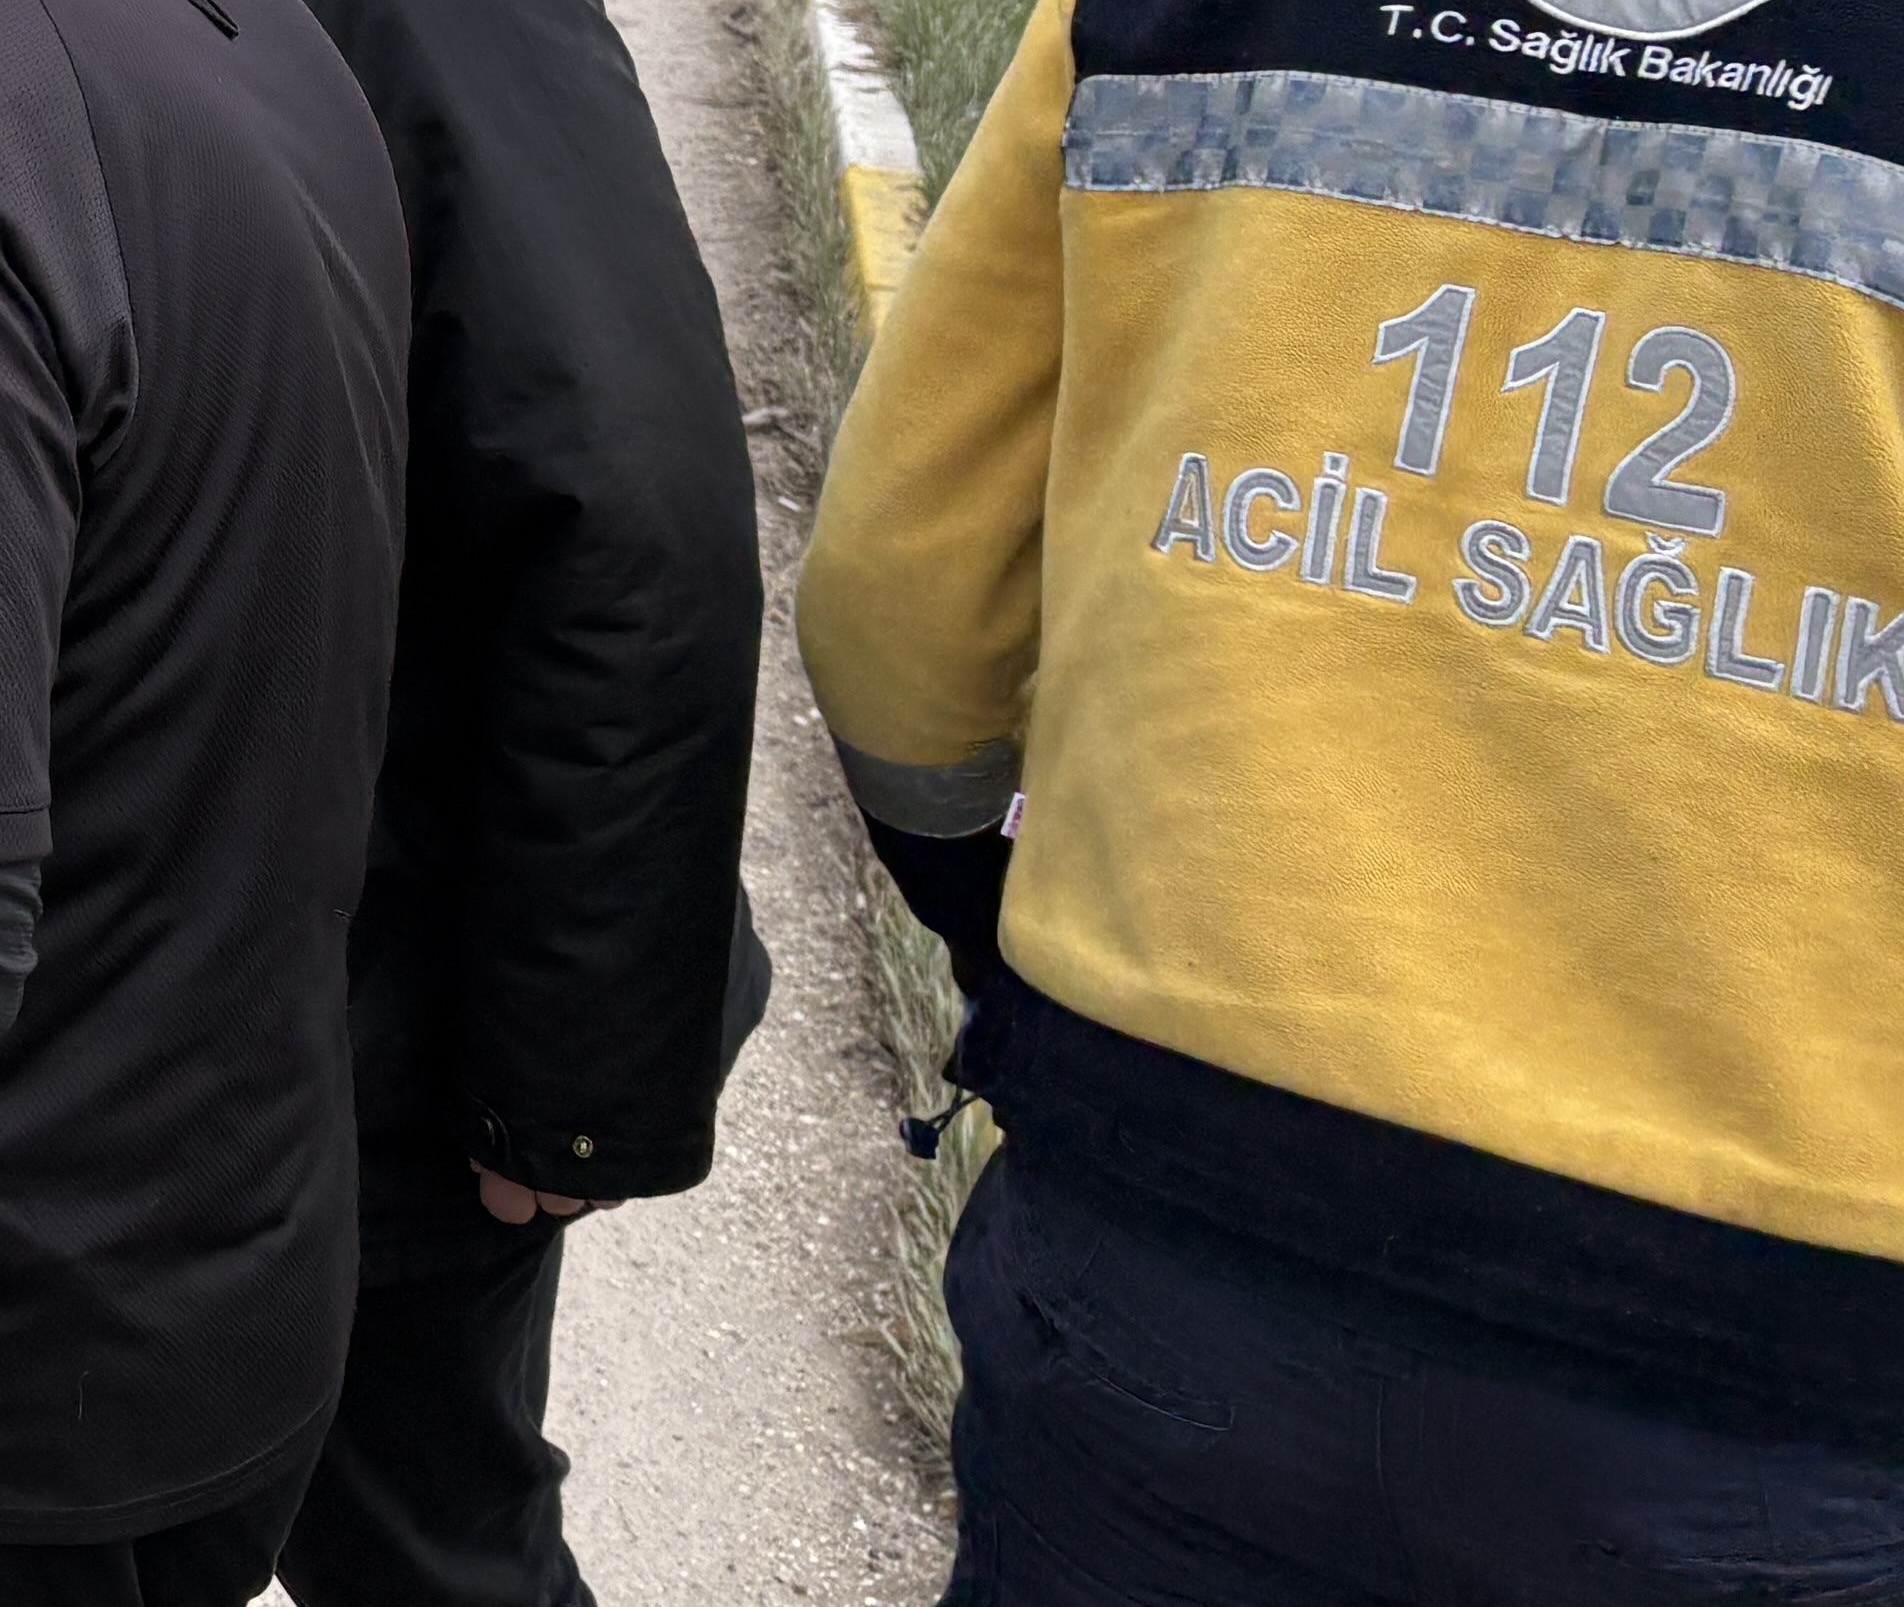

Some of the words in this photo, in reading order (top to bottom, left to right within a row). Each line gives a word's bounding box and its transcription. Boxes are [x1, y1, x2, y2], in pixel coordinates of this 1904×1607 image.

[1380, 4, 1475, 47] T.C.
[1488, 17, 1629, 78] Sağlık
[1637, 44, 1834, 111] Bakanlığı
[1372, 283, 1736, 538] 112
[1151, 451, 1418, 605] ACİL
[1452, 520, 1904, 723] SAĞLIK
